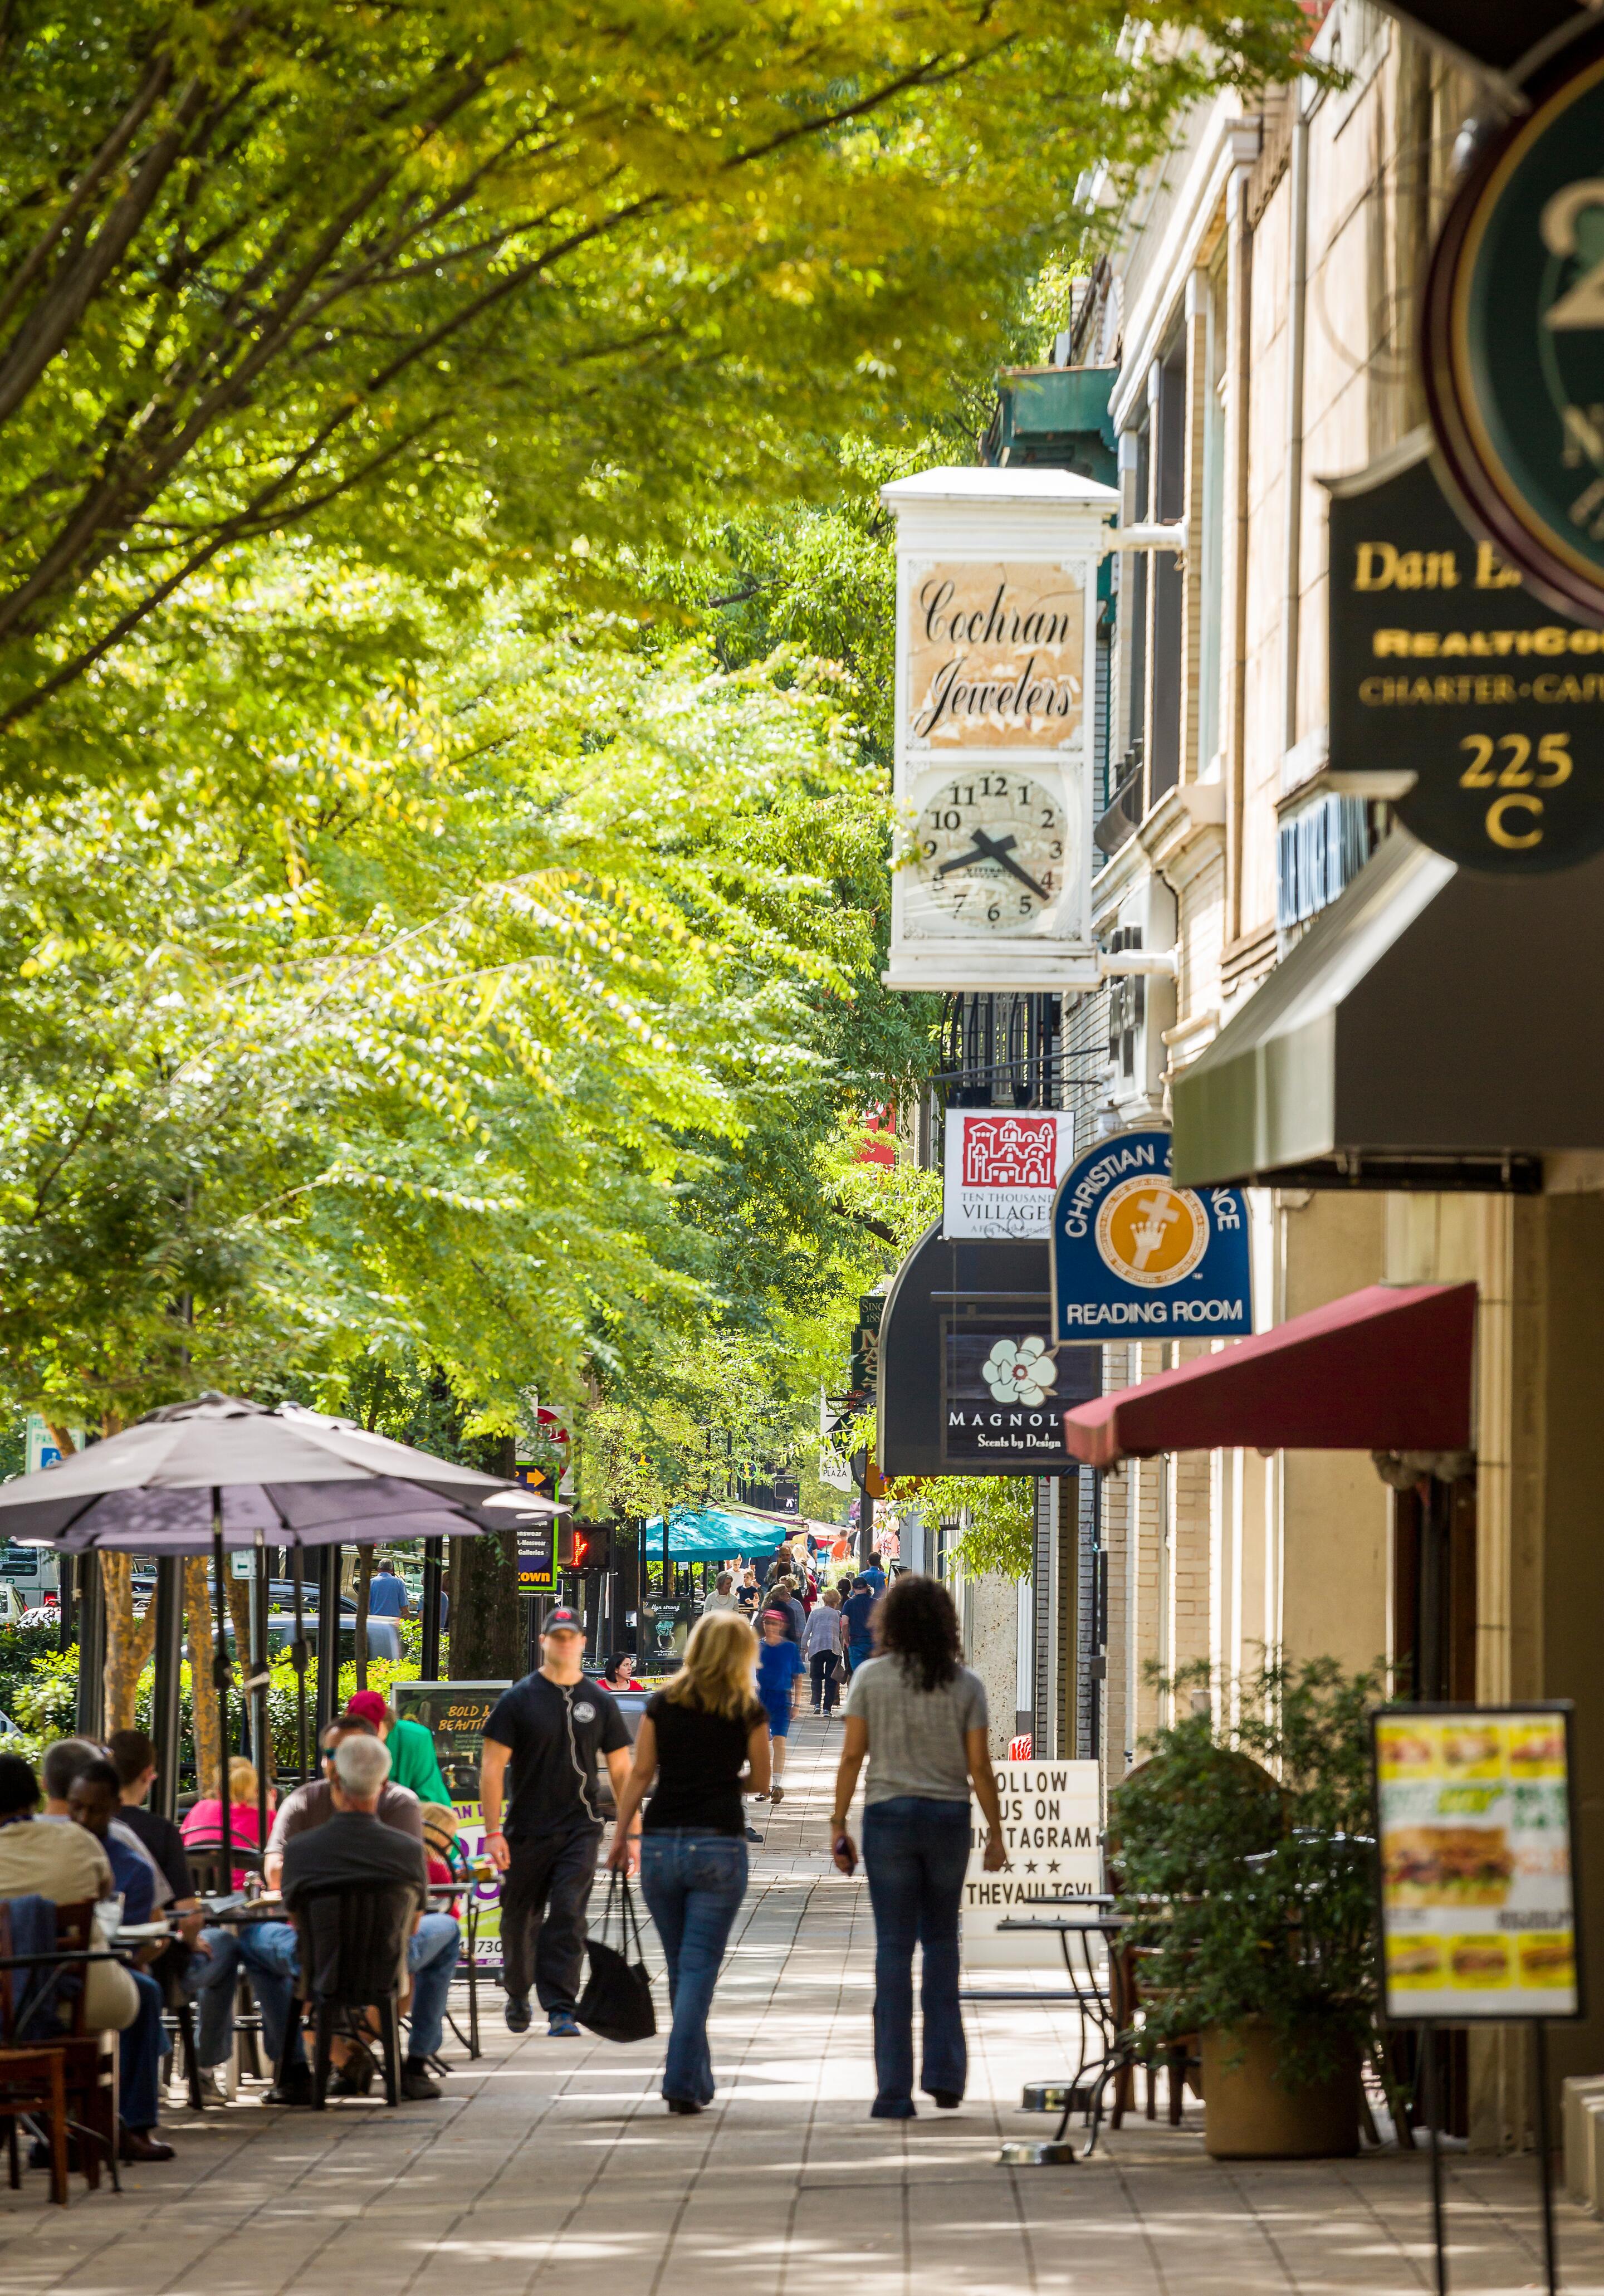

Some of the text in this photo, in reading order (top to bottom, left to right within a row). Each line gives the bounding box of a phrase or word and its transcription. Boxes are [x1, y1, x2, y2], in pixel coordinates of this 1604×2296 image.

[1353, 541, 1460, 591] Dan
[921, 579, 1068, 644] Cochran
[914, 656, 1068, 737] Jewelers
[1458, 732, 1573, 788] 225
[949, 786, 976, 805] 11
[980, 776, 1008, 797] 12
[1018, 786, 1031, 805] 1
[931, 810, 960, 830] 10
[1041, 809, 1054, 828] 2
[1485, 793, 1543, 849] C
[923, 840, 937, 859] 9
[1050, 841, 1062, 859] 3
[1041, 871, 1054, 891] 4
[954, 894, 967, 913] 7
[987, 902, 1000, 921] 6
[1019, 895, 1032, 914] 5
[961, 1193, 984, 1201] TEN
[1065, 1144, 1155, 1238] CHRISTIAN
[962, 1204, 1053, 1220] VILLAGE
[862, 1300, 884, 1313] SINC
[1067, 1300, 1243, 1325] READING ROOM
[866, 1312, 881, 1323] 188
[948, 1411, 1059, 1427] MAGNOL
[977, 1433, 1061, 1449] Scents by Design
[448, 1706, 479, 1717] BOLD
[997, 1771, 1068, 1793] OLLOW
[1035, 1800, 1060, 1821] ON
[971, 1827, 1092, 1849] INTAGRAM
